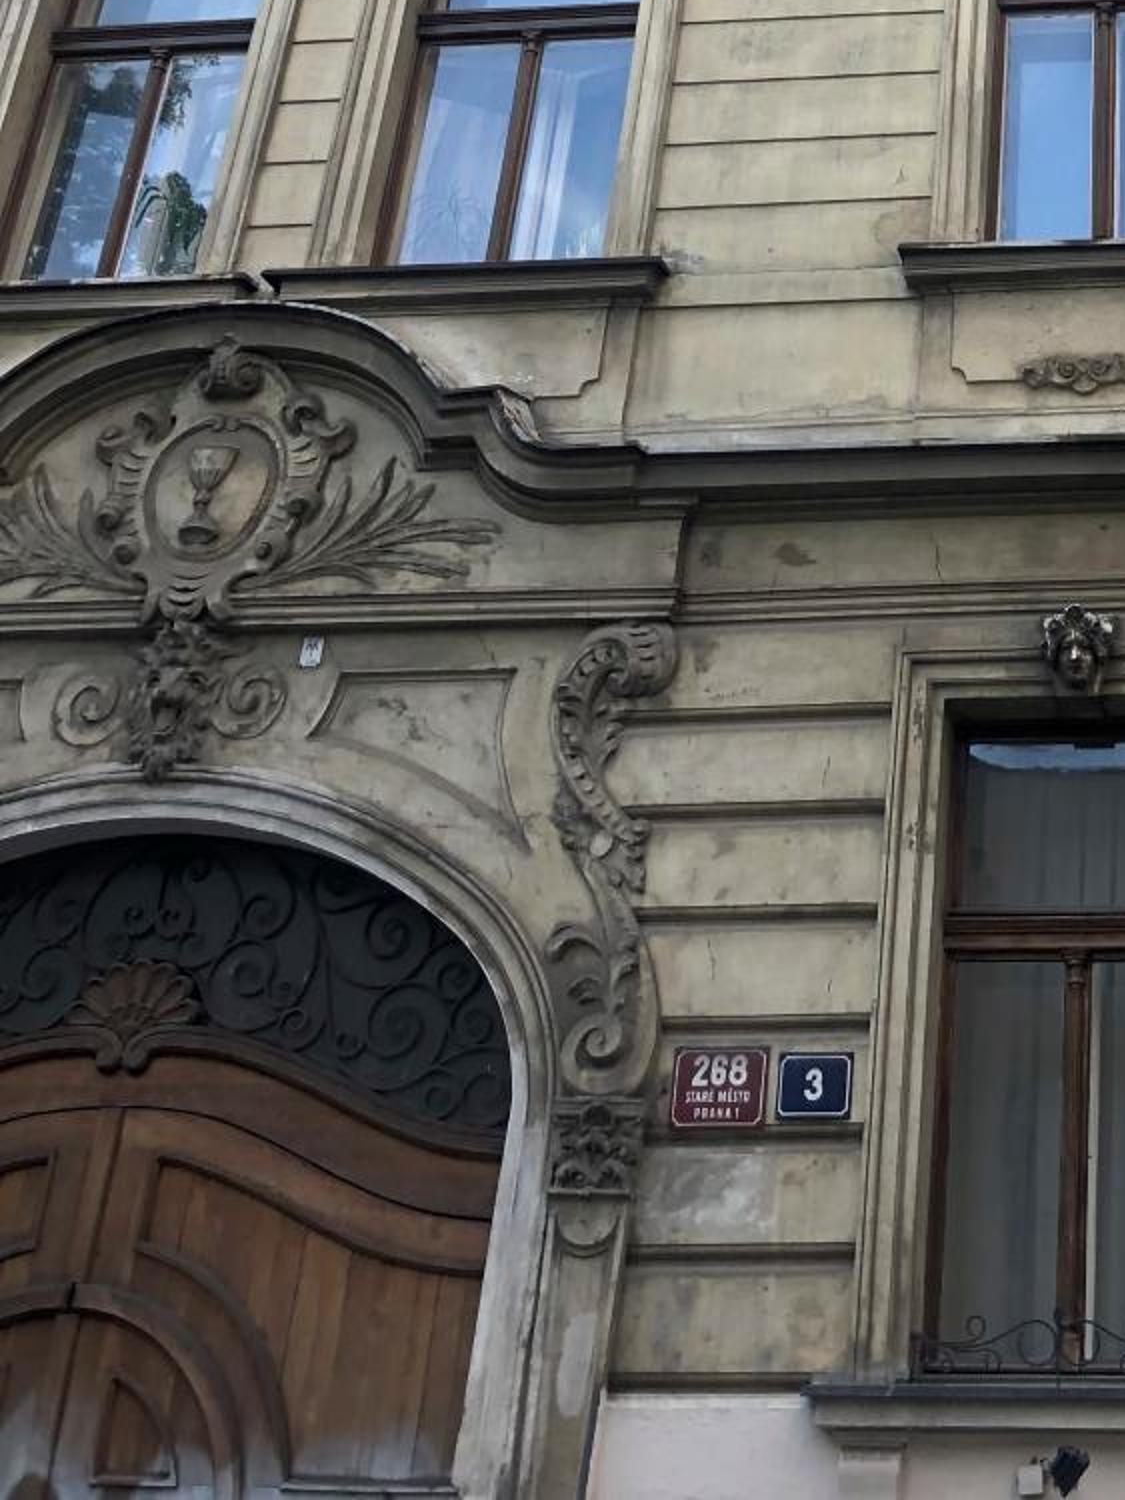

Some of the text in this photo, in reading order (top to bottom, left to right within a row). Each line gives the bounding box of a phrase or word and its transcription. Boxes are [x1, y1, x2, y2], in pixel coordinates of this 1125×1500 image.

[691, 1054, 748, 1087] 268
[803, 1068, 823, 1101] 3
[693, 1107, 732, 1119] PRAHA
